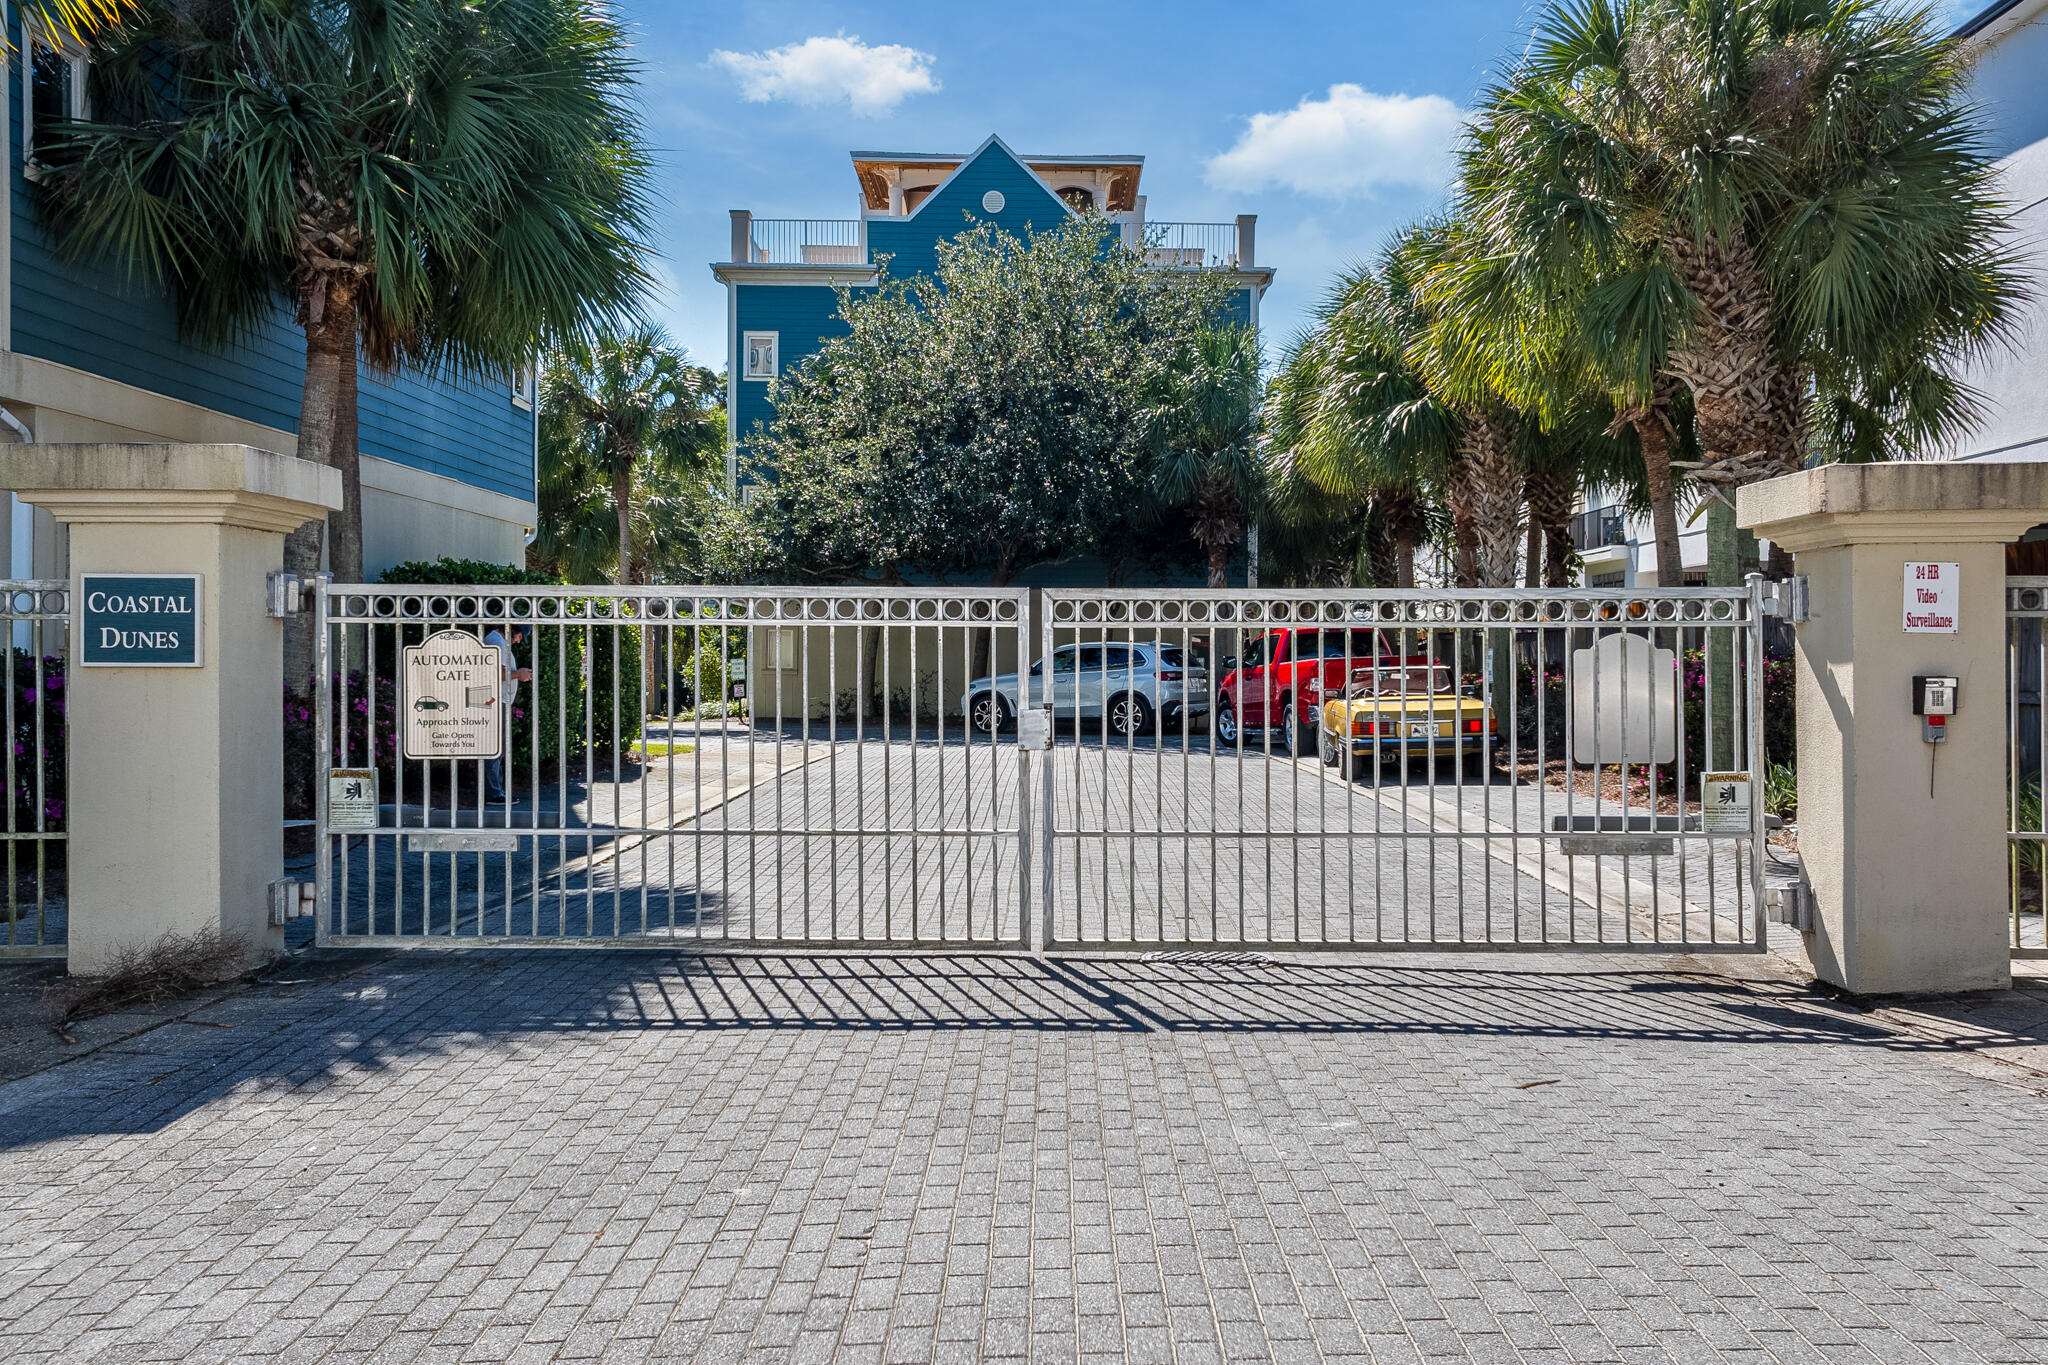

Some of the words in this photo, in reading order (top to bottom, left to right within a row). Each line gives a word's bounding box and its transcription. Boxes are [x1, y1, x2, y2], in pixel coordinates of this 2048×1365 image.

[1916, 566, 1925, 579] 24
[1928, 564, 1939, 579] HR
[88, 591, 192, 614] COASTAL
[1916, 588, 1938, 604] Video
[1906, 612, 1952, 628] Surveillance
[100, 627, 178, 649] DUNES
[412, 654, 494, 666] AUTOMATIC
[436, 670, 470, 681] GATE
[416, 718, 458, 728] Approach
[461, 718, 490, 728] Slowly
[451, 732, 474, 740] Opens
